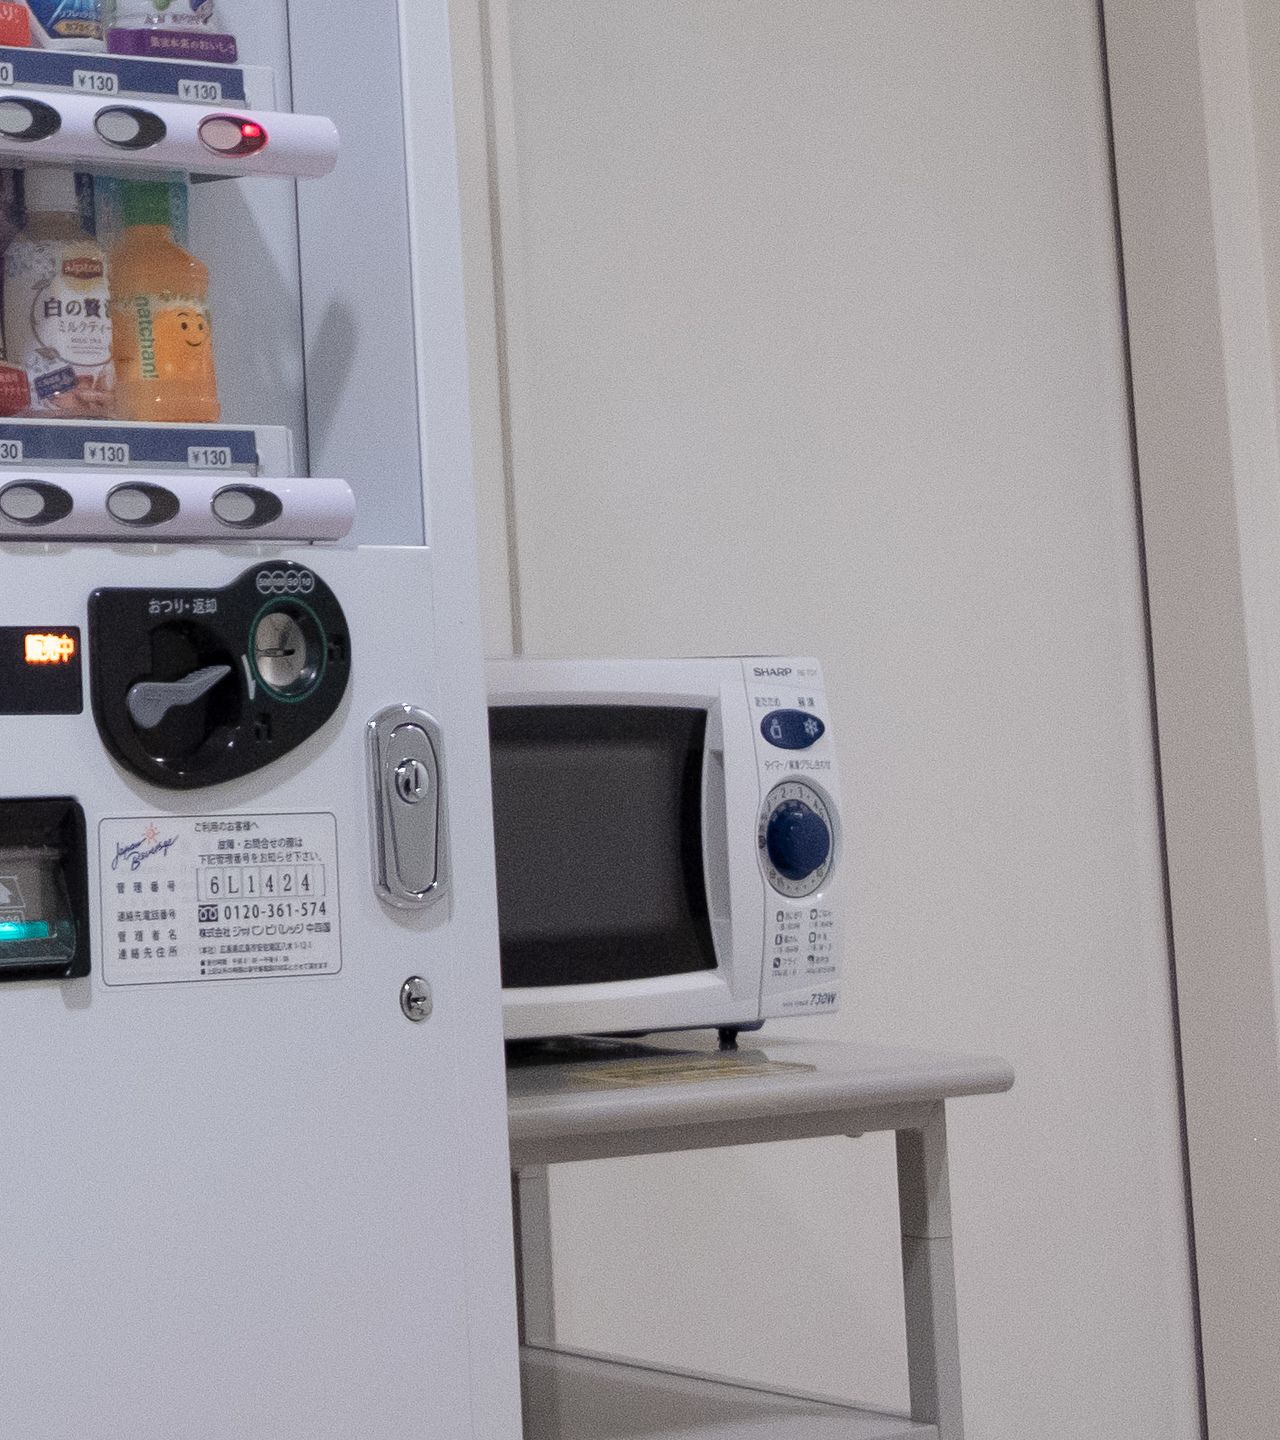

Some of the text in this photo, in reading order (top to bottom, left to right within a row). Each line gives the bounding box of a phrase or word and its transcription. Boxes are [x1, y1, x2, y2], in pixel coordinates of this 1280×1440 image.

[78, 74, 115, 92] ¥130
[182, 83, 218, 101] ¥130
[87, 444, 125, 463] ¥130
[192, 448, 227, 467] ¥130
[148, 598, 218, 614] おつり・返却
[753, 666, 793, 677] SHARP
[194, 820, 259, 833] ご利用のお客様へ
[223, 901, 328, 921] 0120-361-574
